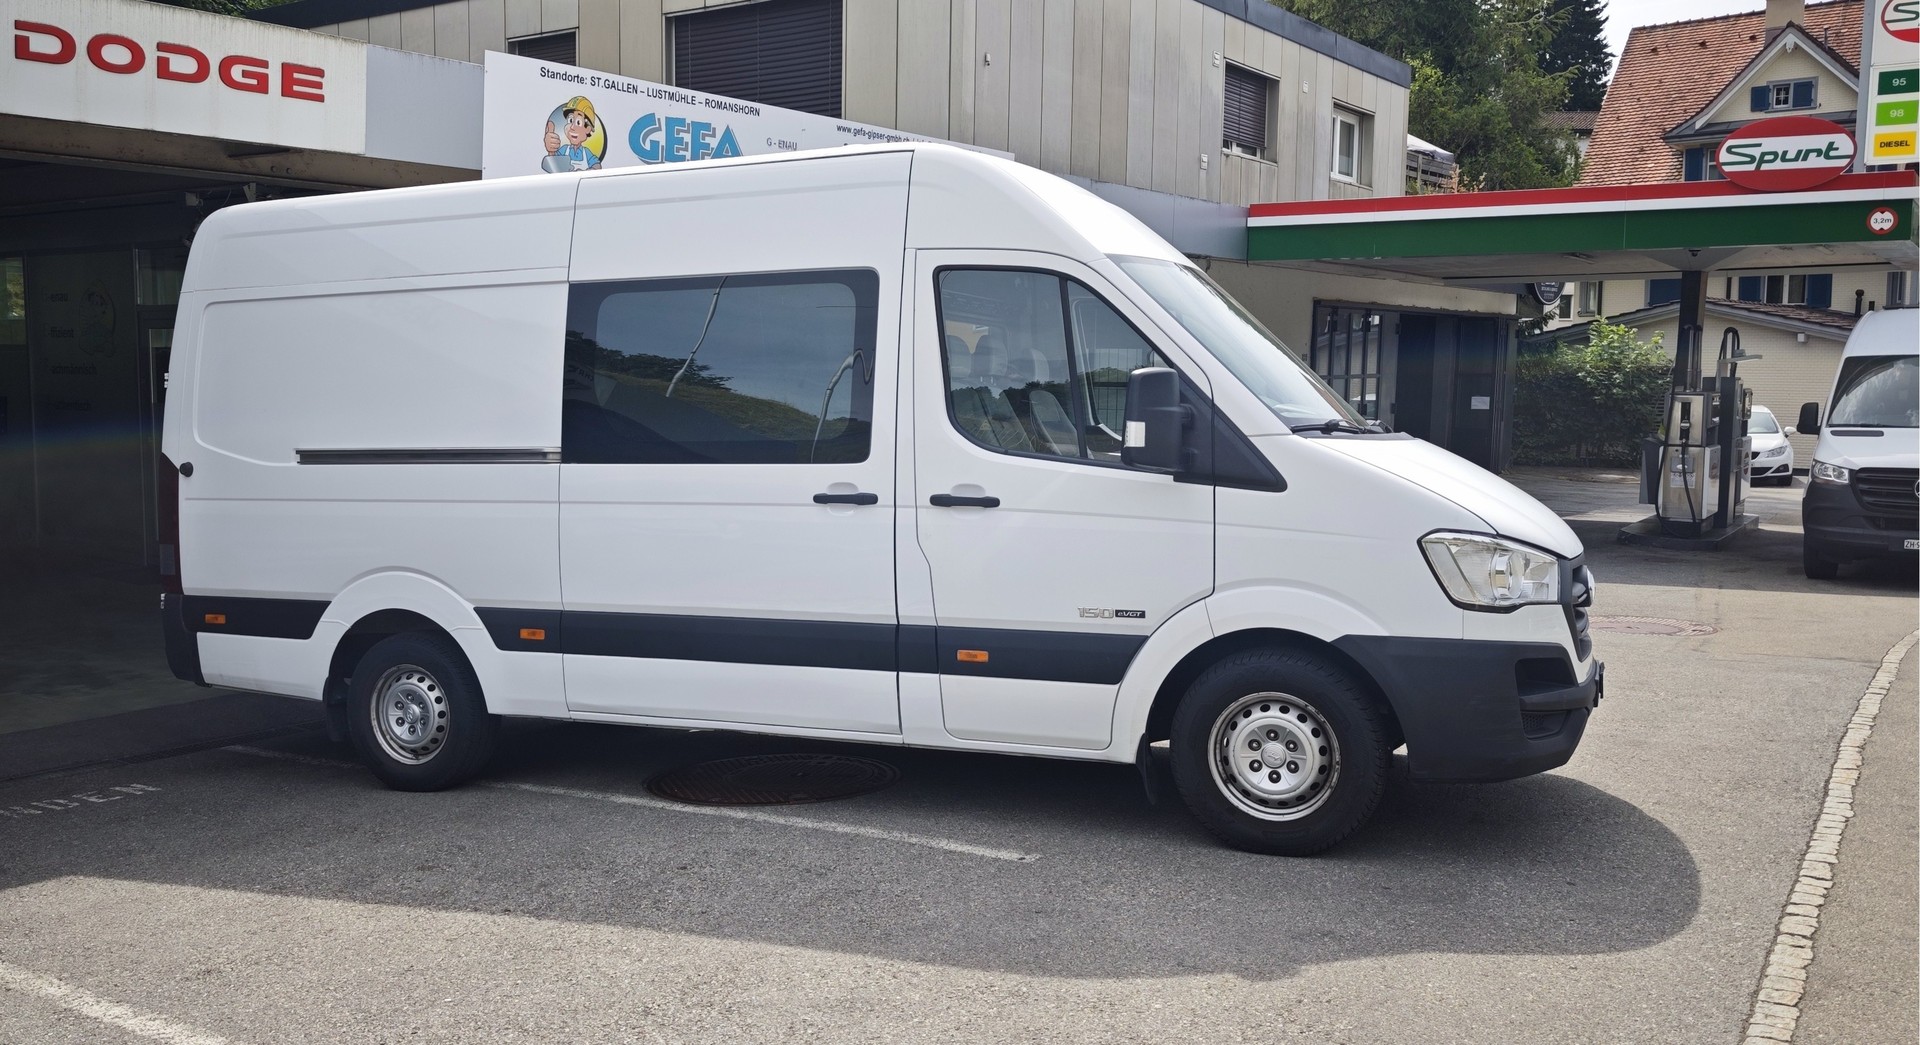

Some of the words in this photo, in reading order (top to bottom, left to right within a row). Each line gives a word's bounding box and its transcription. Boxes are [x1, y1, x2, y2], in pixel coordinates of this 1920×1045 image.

[14, 19, 325, 103] DODGE
[1892, 78, 1907, 87] 95
[540, 66, 587, 85] Standorte:
[590, 76, 638, 95] ST.GALLEN
[647, 87, 696, 106] LUSTMÜHLE
[704, 98, 761, 117] ROMANSHORN
[1889, 109, 1904, 118] 98
[628, 112, 743, 164] GEFA
[836, 124, 910, 143] www.gefa-gipser-gmbhch
[1879, 140, 1910, 148] DIESEL
[1722, 141, 1853, 171] Spurt
[1873, 217, 1892, 225] 3,2m
[1077, 606, 1114, 619] 150
